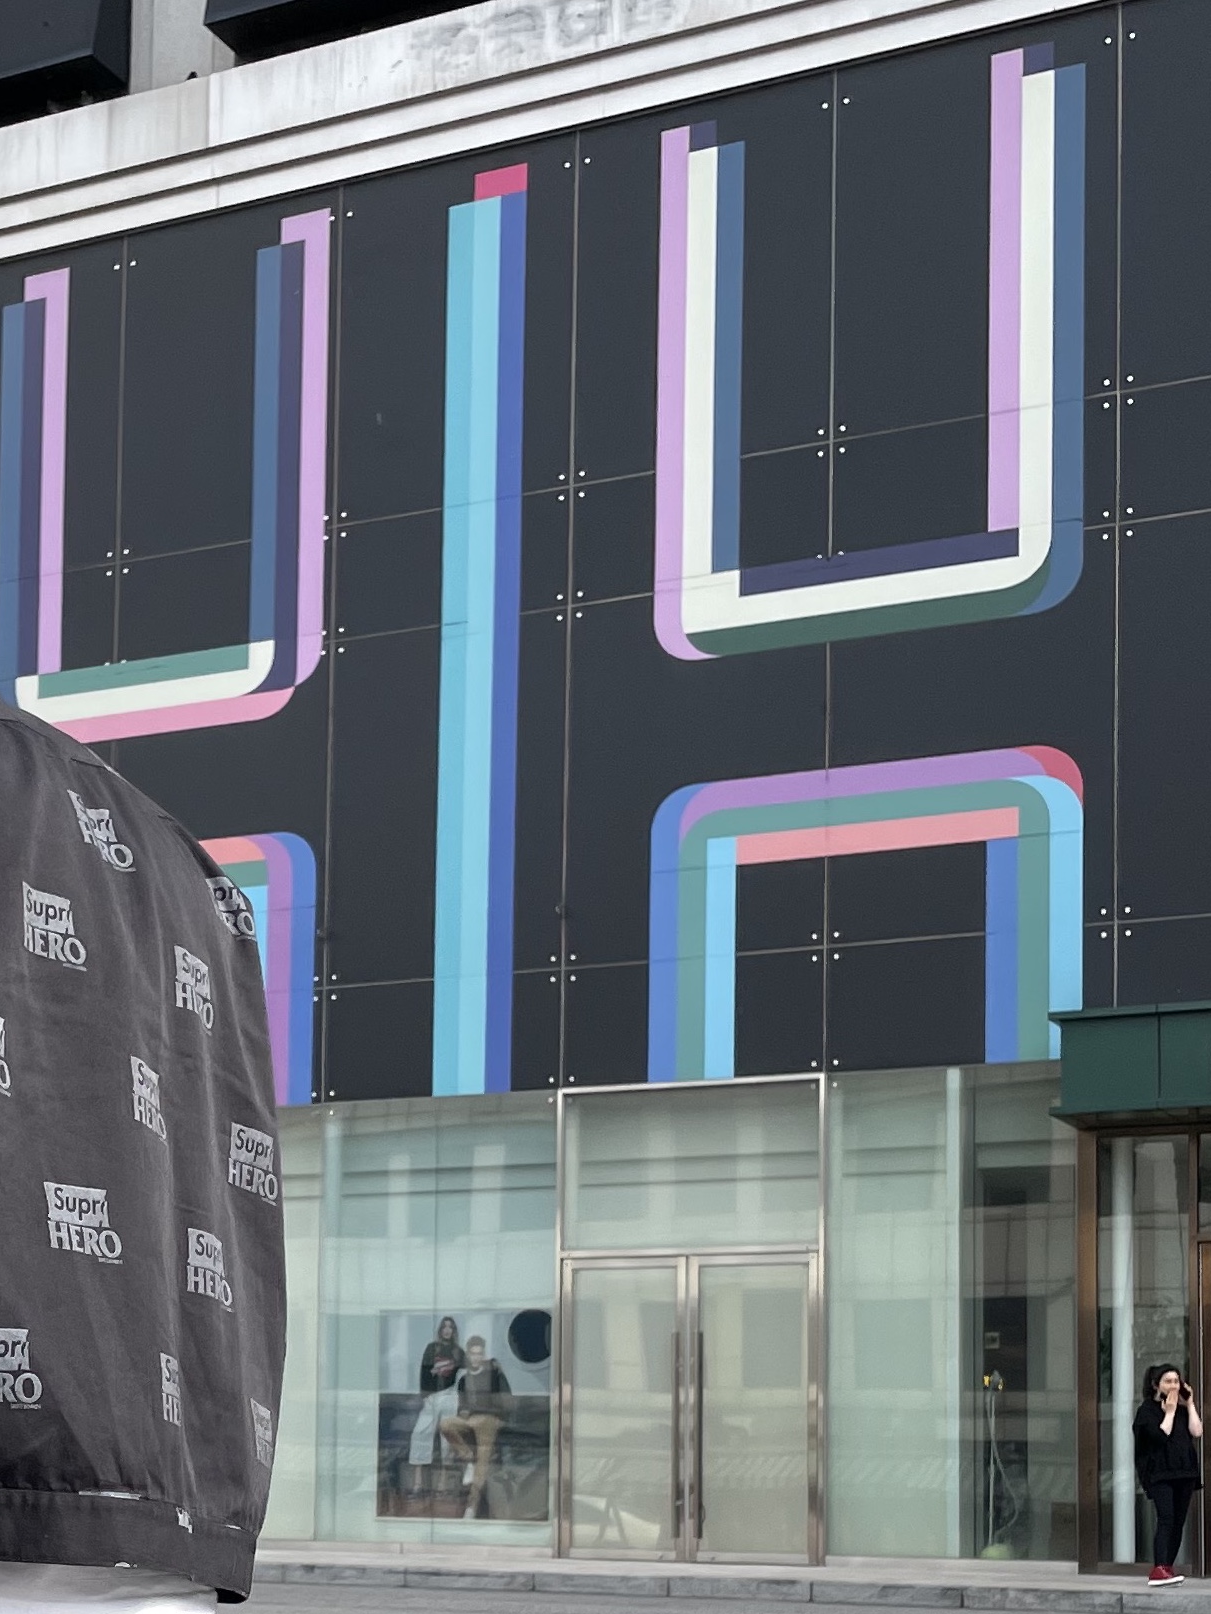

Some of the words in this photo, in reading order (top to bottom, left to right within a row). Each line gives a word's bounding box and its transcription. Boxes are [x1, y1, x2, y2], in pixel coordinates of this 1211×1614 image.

[24, 921, 87, 965] HERO
[228, 1157, 279, 1200] HERO
[47, 1220, 123, 1259] HERO
